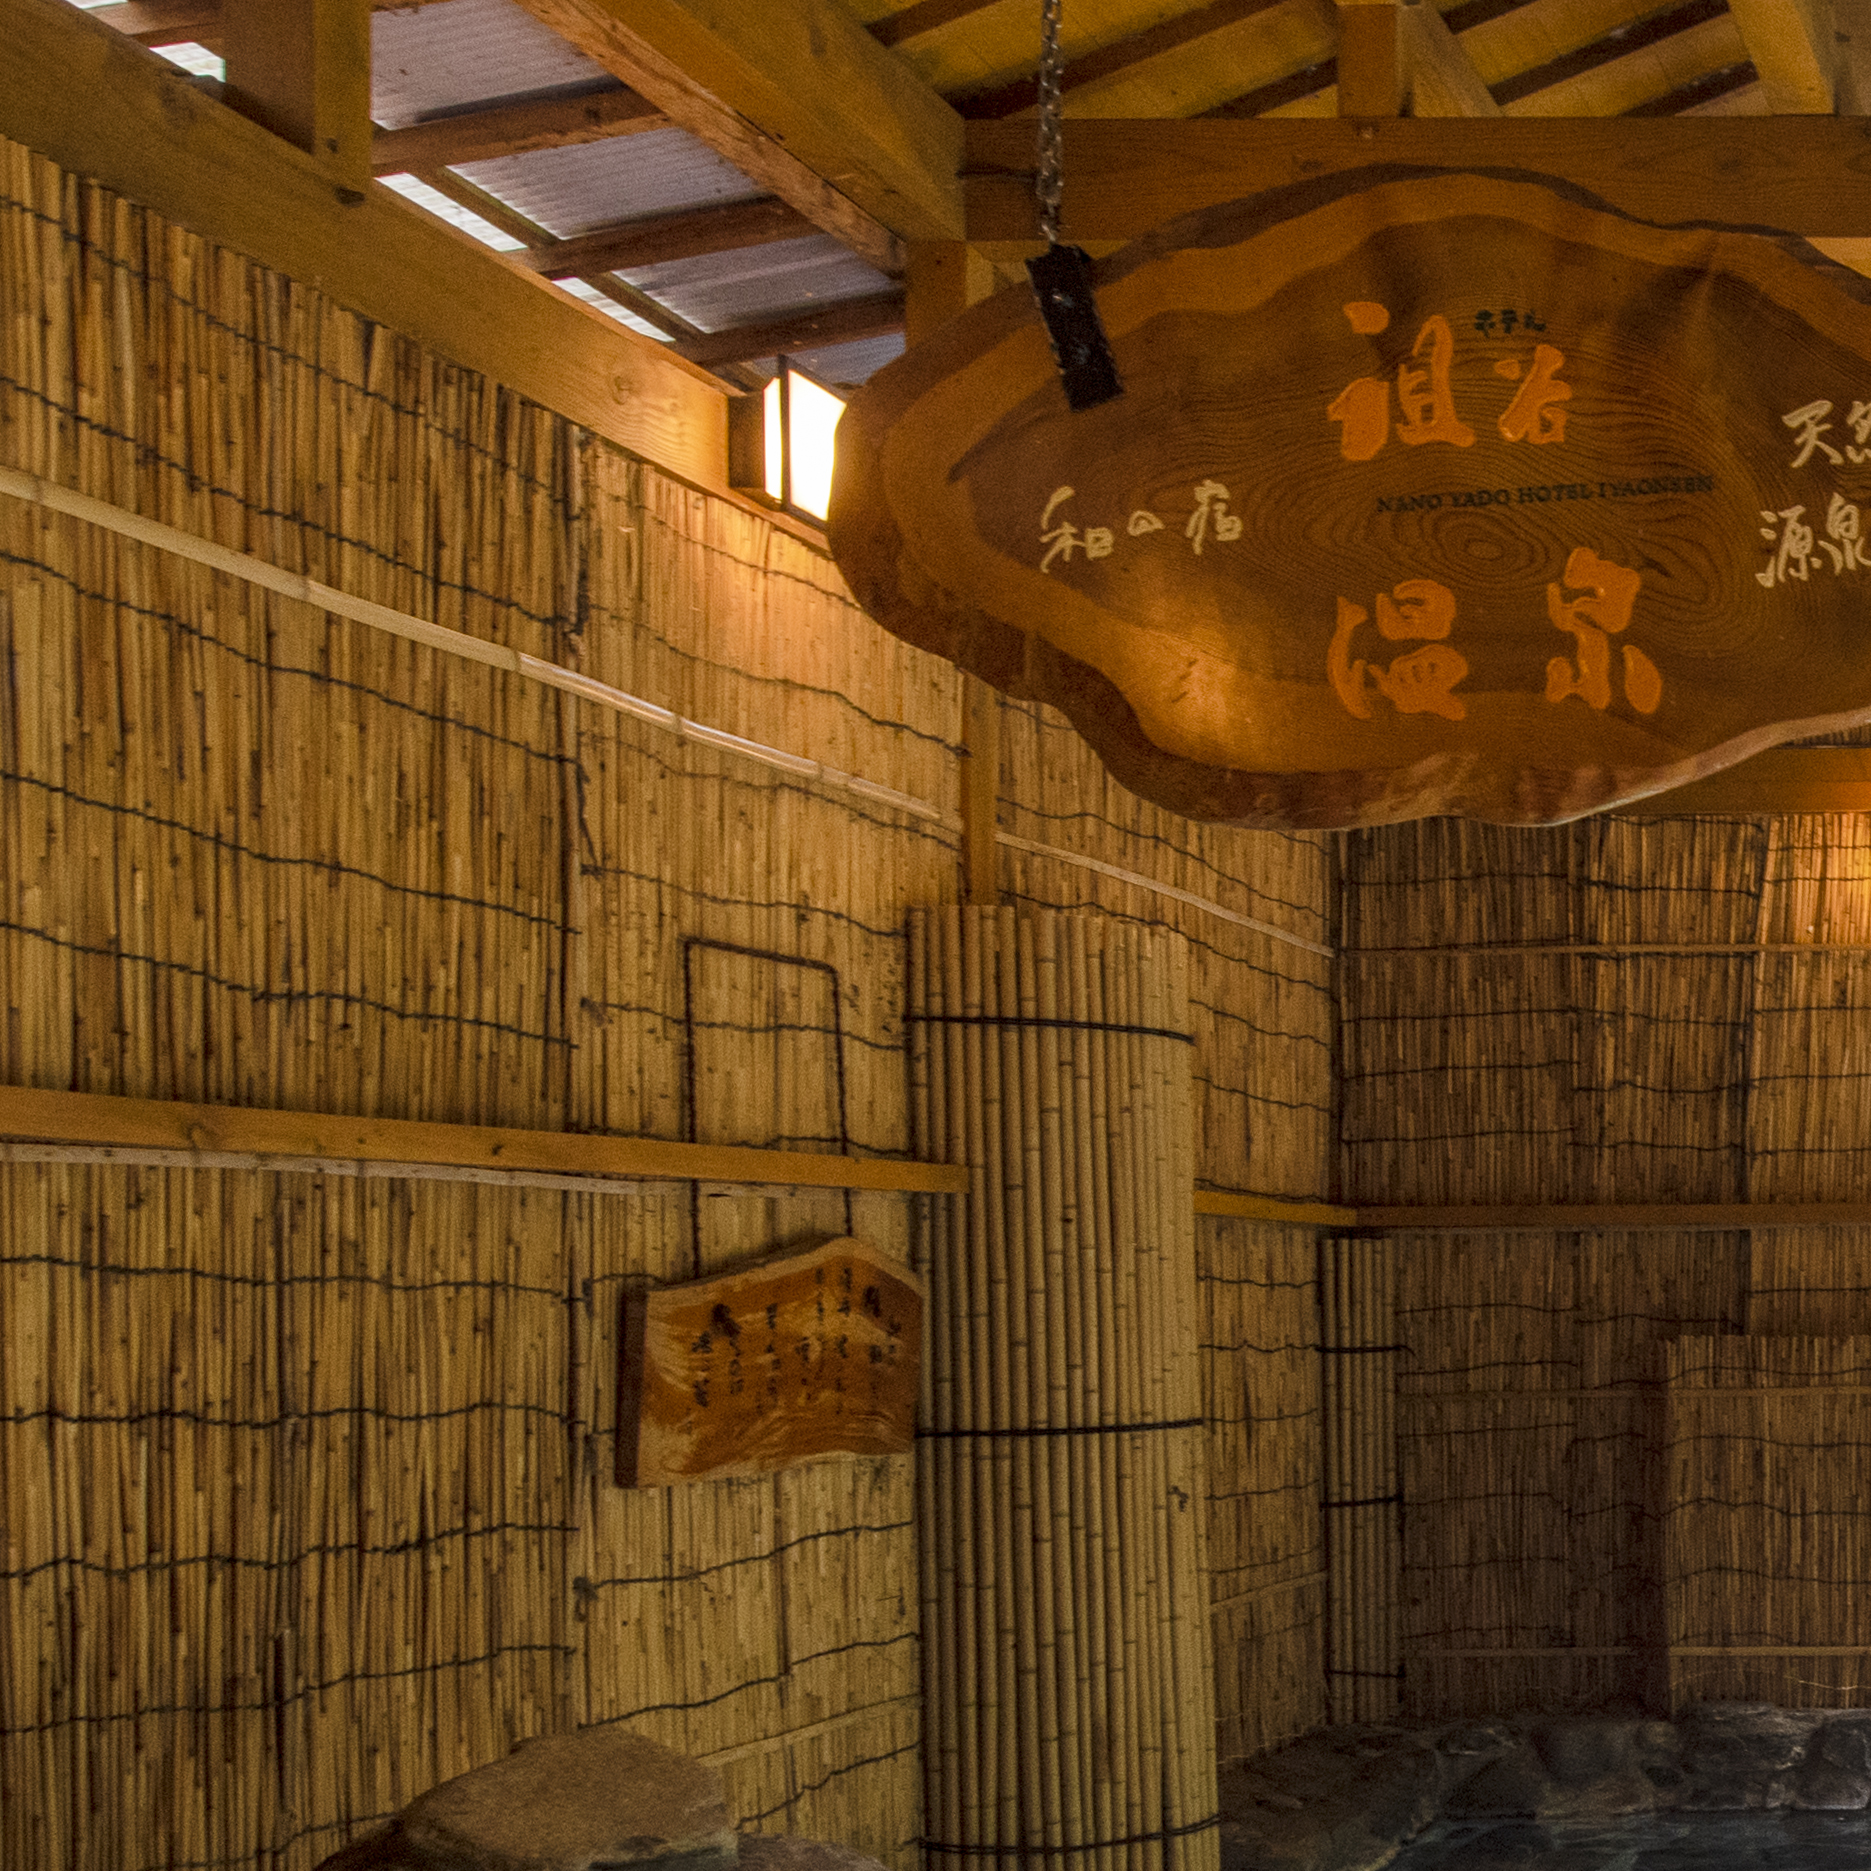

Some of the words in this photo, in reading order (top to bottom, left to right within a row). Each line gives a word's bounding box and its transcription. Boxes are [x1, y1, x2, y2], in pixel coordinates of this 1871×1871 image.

[1327, 301, 1572, 462] 祖谷
[1039, 479, 1243, 574] 和の宿
[1518, 482, 1593, 504] HOTEL
[1326, 547, 1663, 721] 温泉
